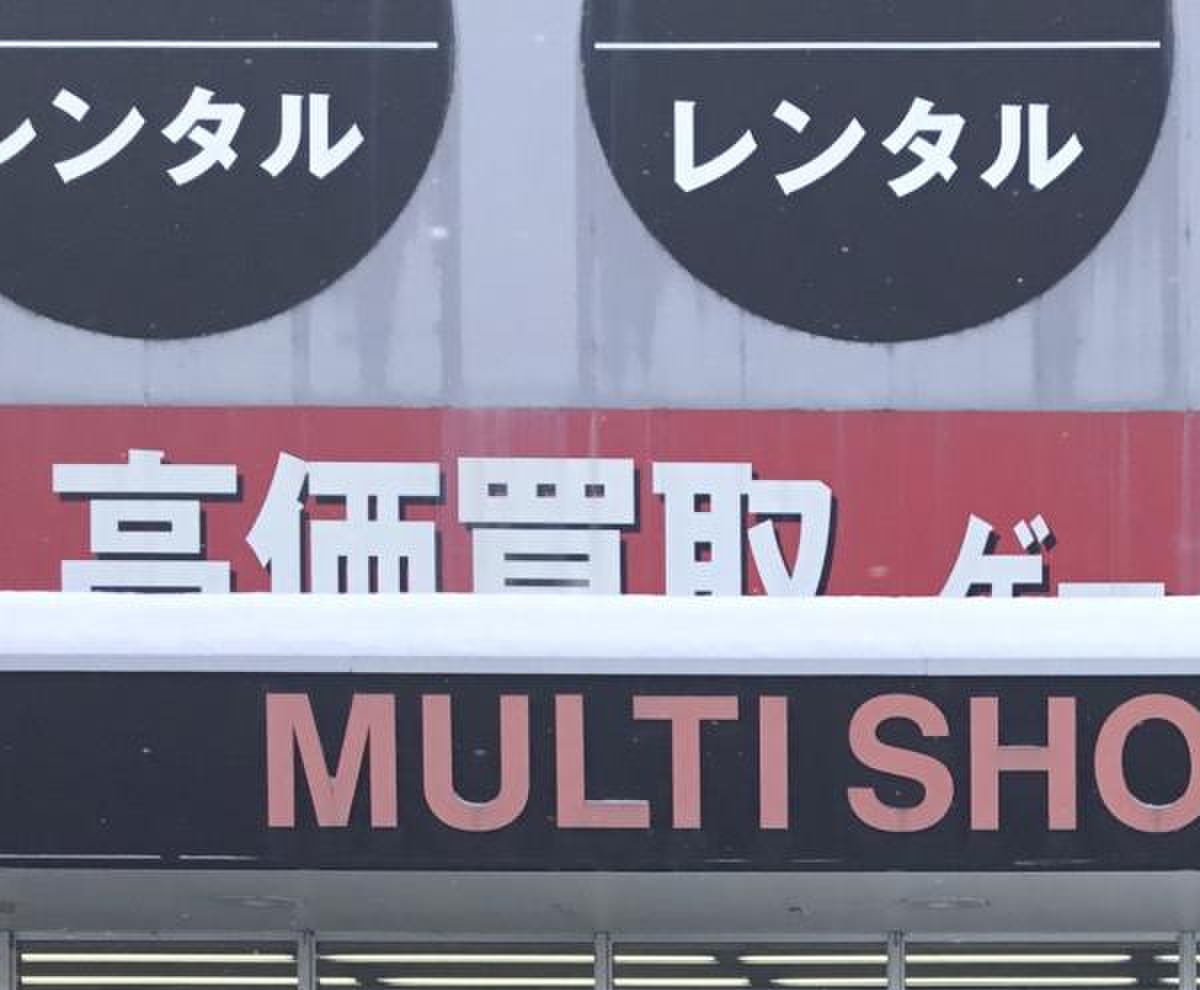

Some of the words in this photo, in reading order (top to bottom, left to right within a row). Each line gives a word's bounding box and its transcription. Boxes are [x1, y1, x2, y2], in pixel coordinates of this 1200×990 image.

[674, 97, 1084, 197] レンタル
[52, 450, 833, 594] 高価買取
[265, 692, 790, 832] MULTI
